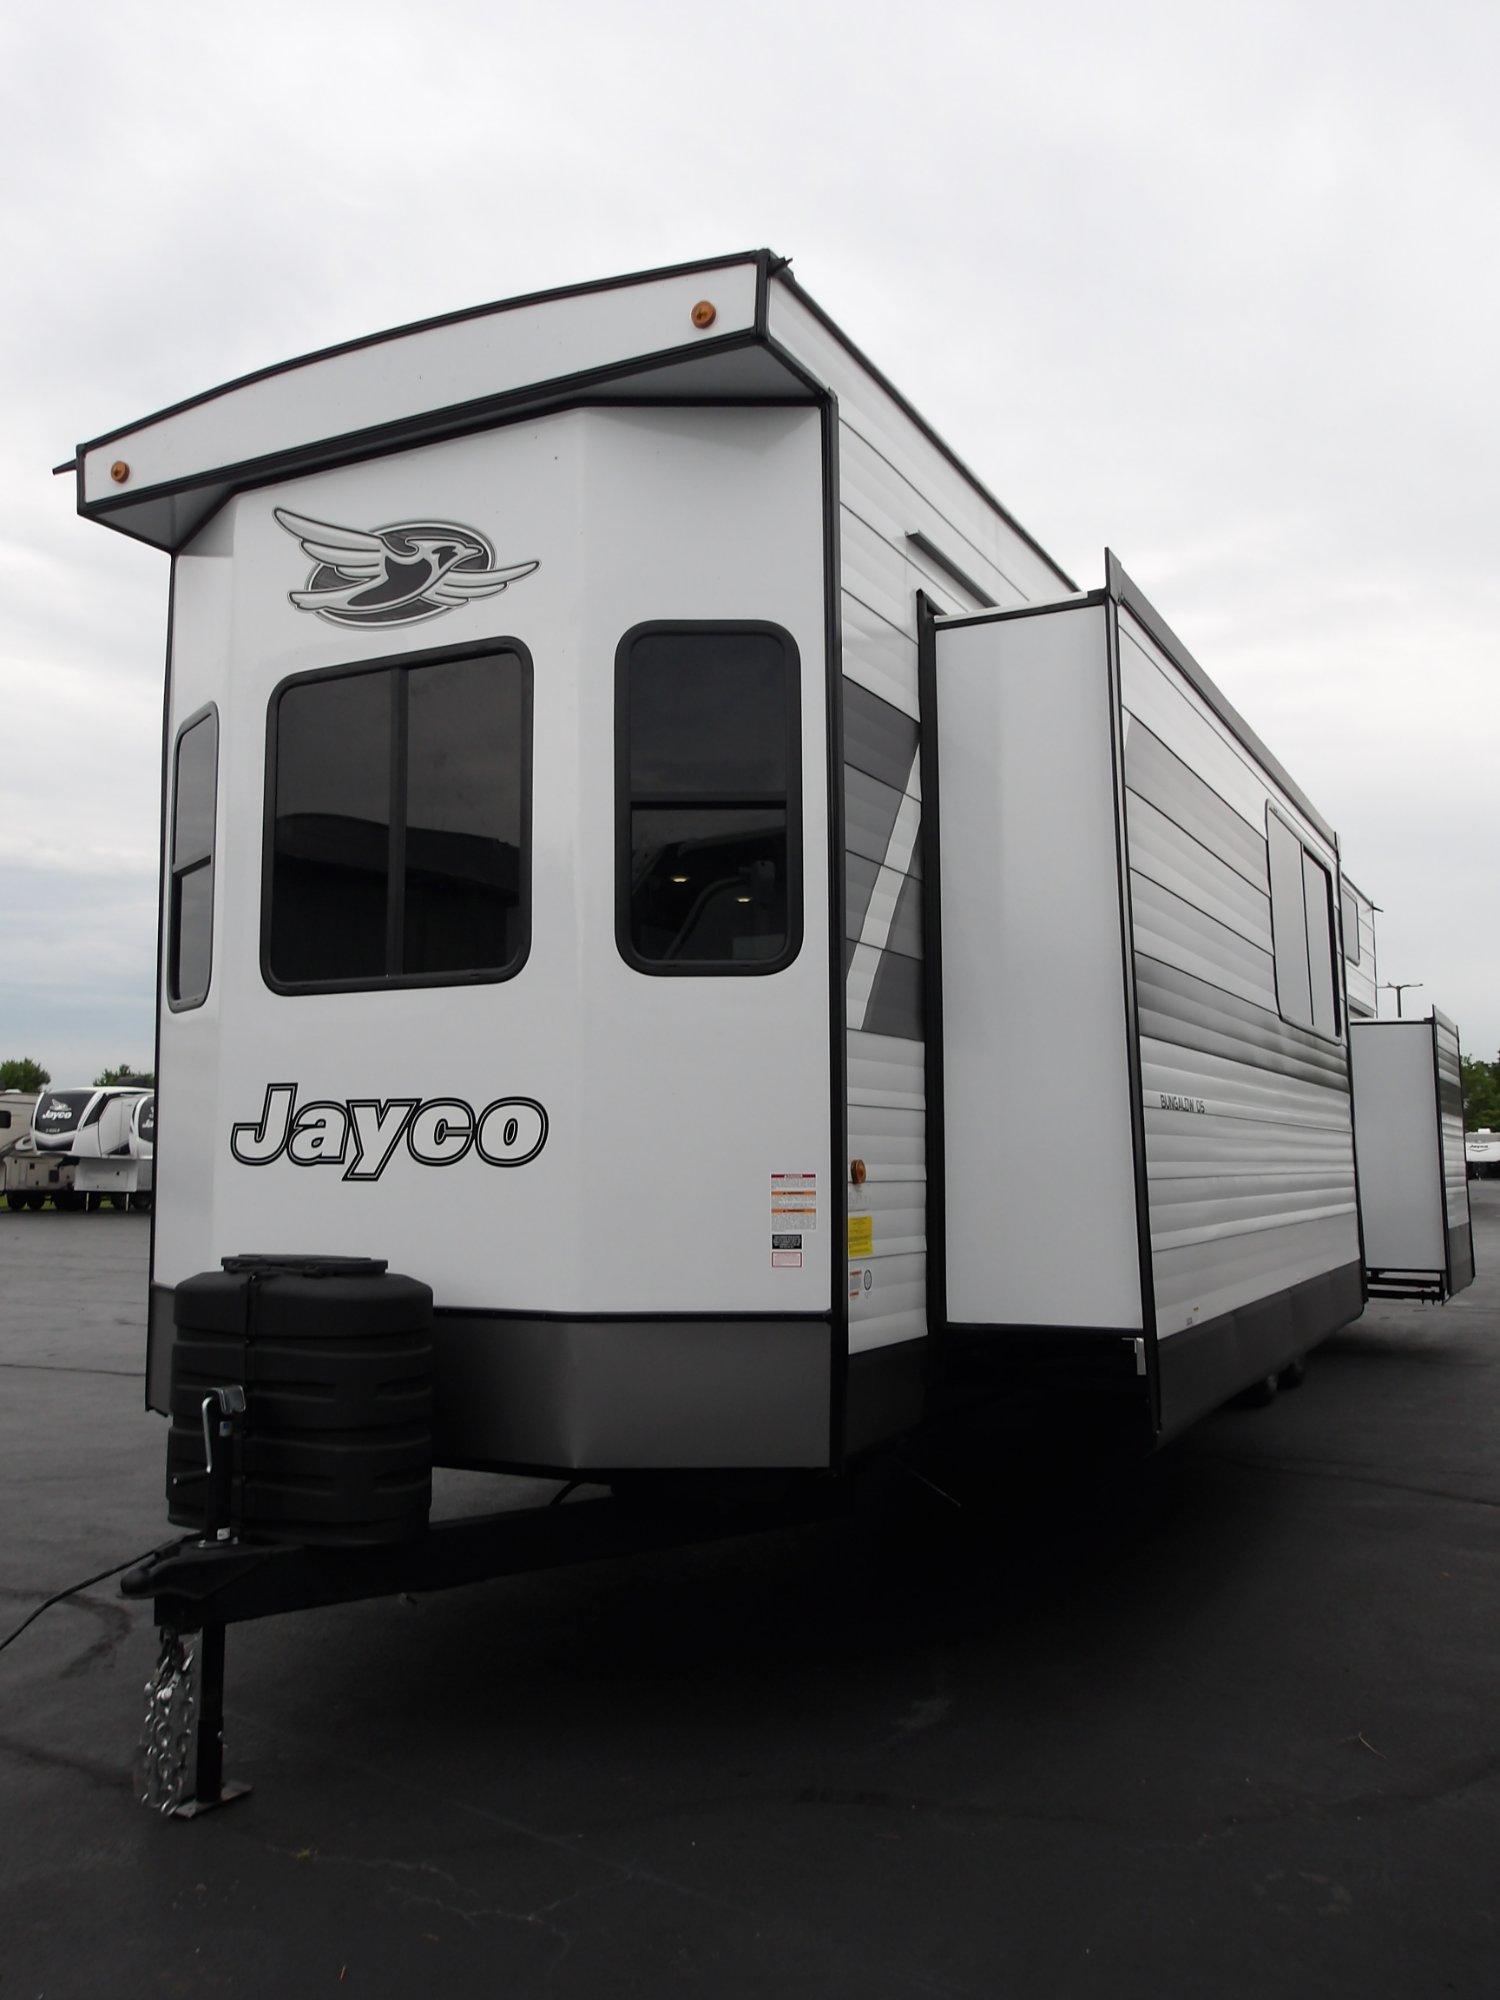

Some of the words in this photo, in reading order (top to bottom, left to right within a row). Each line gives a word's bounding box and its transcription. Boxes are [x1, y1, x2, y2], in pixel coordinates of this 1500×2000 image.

[1160, 1094, 1194, 1112] BUNGALOW
[42, 1110, 73, 1120] Jayco
[231, 1082, 549, 1181] Jayco
